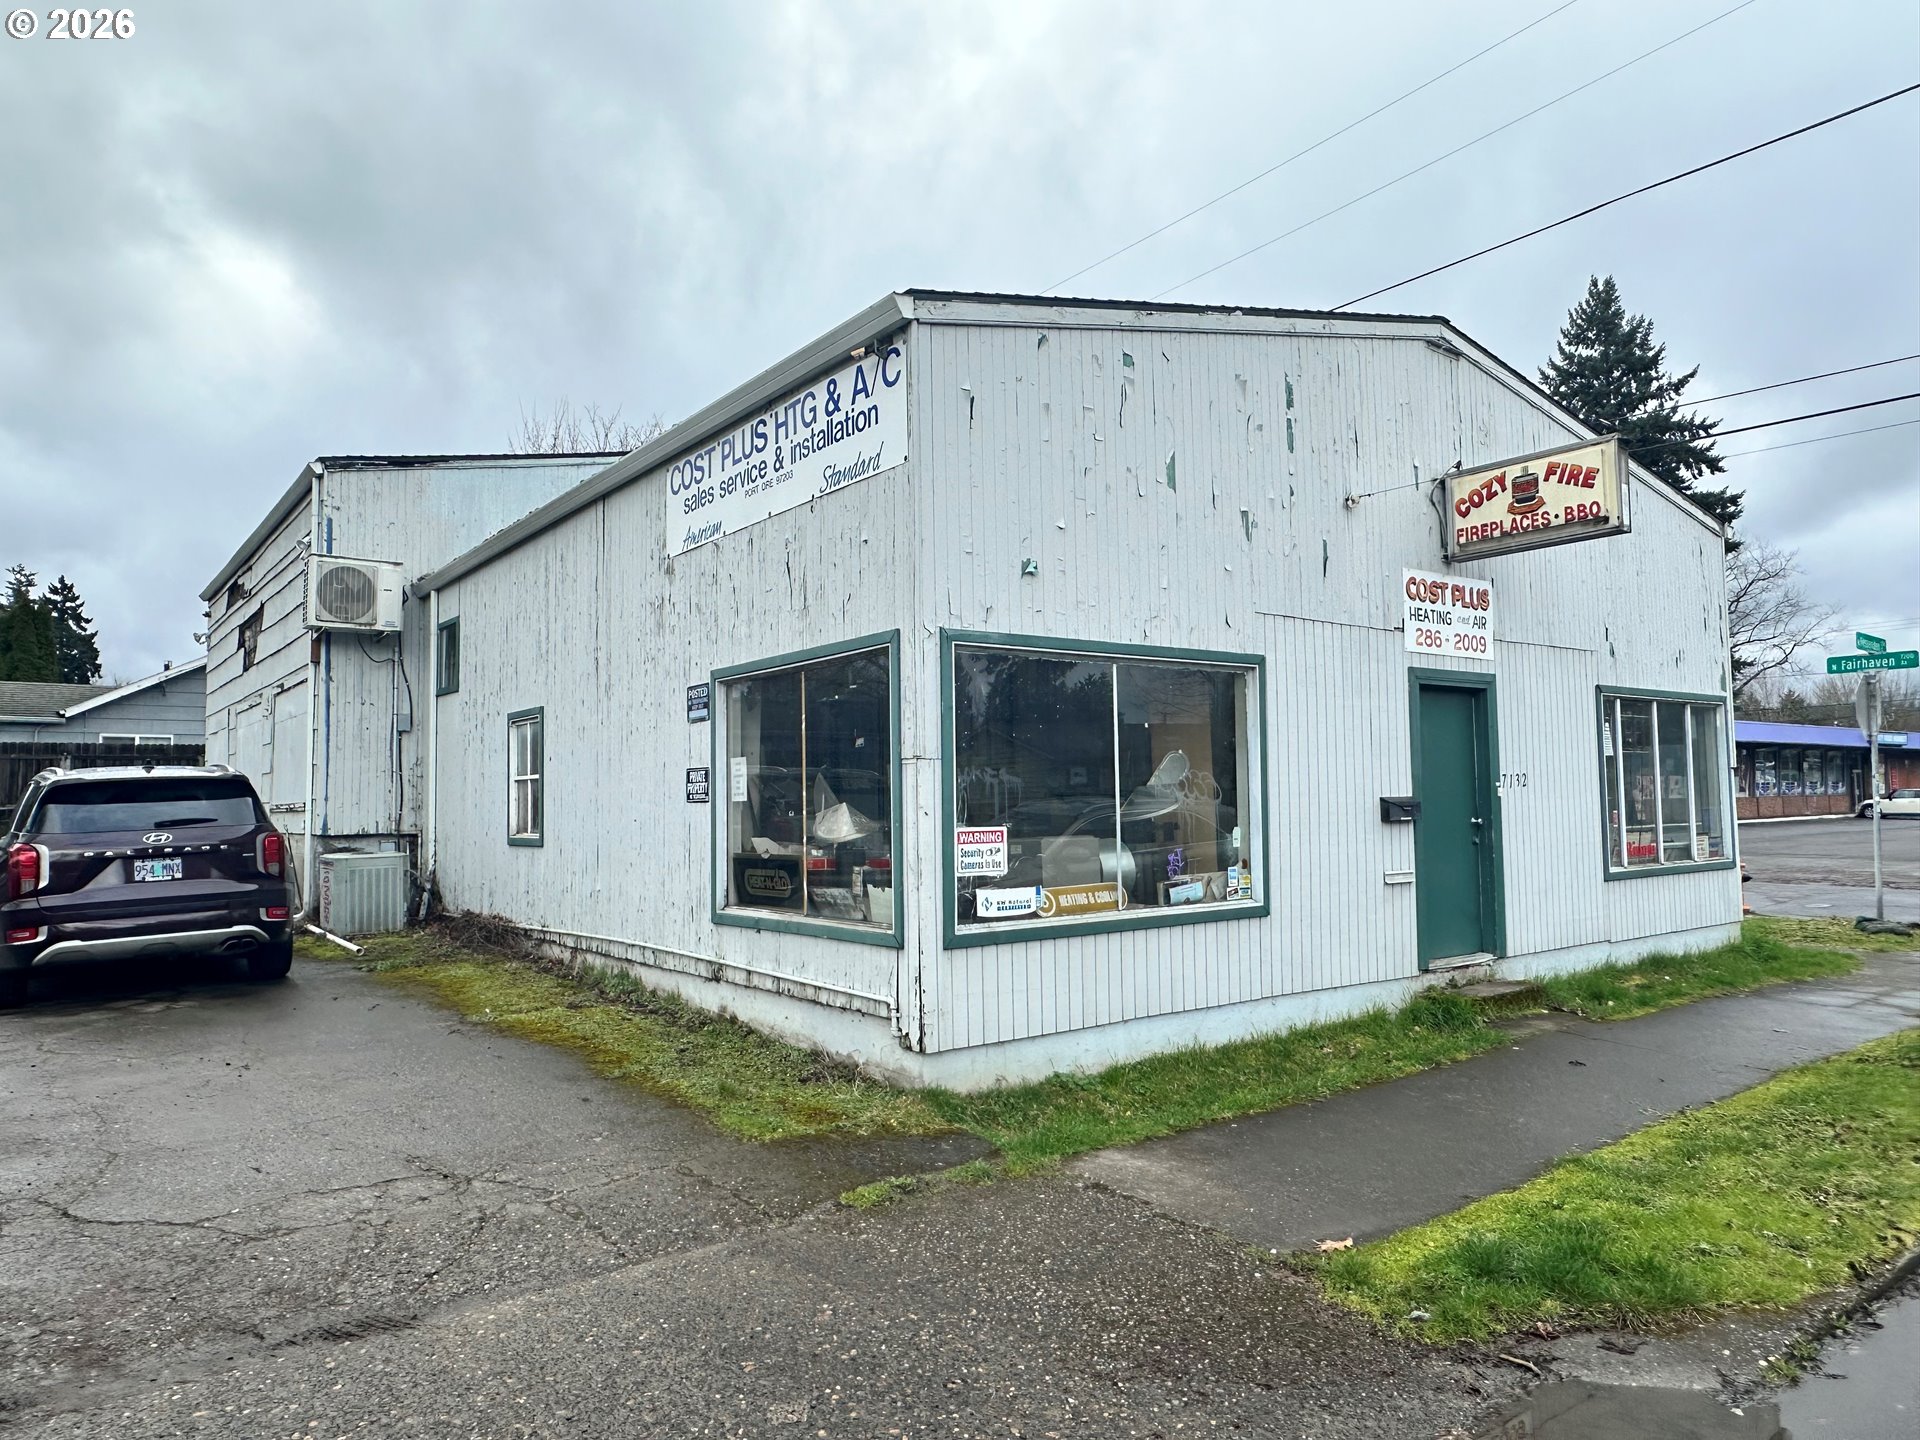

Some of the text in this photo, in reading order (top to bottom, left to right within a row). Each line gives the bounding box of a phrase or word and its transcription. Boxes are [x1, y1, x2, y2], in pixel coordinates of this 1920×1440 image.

[670, 346, 901, 495] COST PLUS HTG & A/C
[683, 404, 879, 515] sales service & installation
[819, 441, 884, 494] Standard
[744, 469, 794, 499] PORT ORE 97203
[1455, 461, 1600, 519] COZY FIRE
[682, 520, 722, 552] American
[1456, 511, 1551, 544] FIREPLACES
[1405, 576, 1491, 612] COST PLUS
[1409, 606, 1487, 630] HEATING and AIR
[1841, 657, 1895, 670] Fairhaven
[688, 687, 708, 699] POSTED
[1501, 773, 1527, 789] 7132
[959, 831, 1003, 843] WARNING
[960, 848, 984, 859] Security
[960, 860, 984, 870] Cameras
[991, 859, 1002, 869] Use
[135, 862, 181, 877] 954 MNX
[1058, 892, 1088, 907] HEATING
[1088, 891, 1095, 904] &
